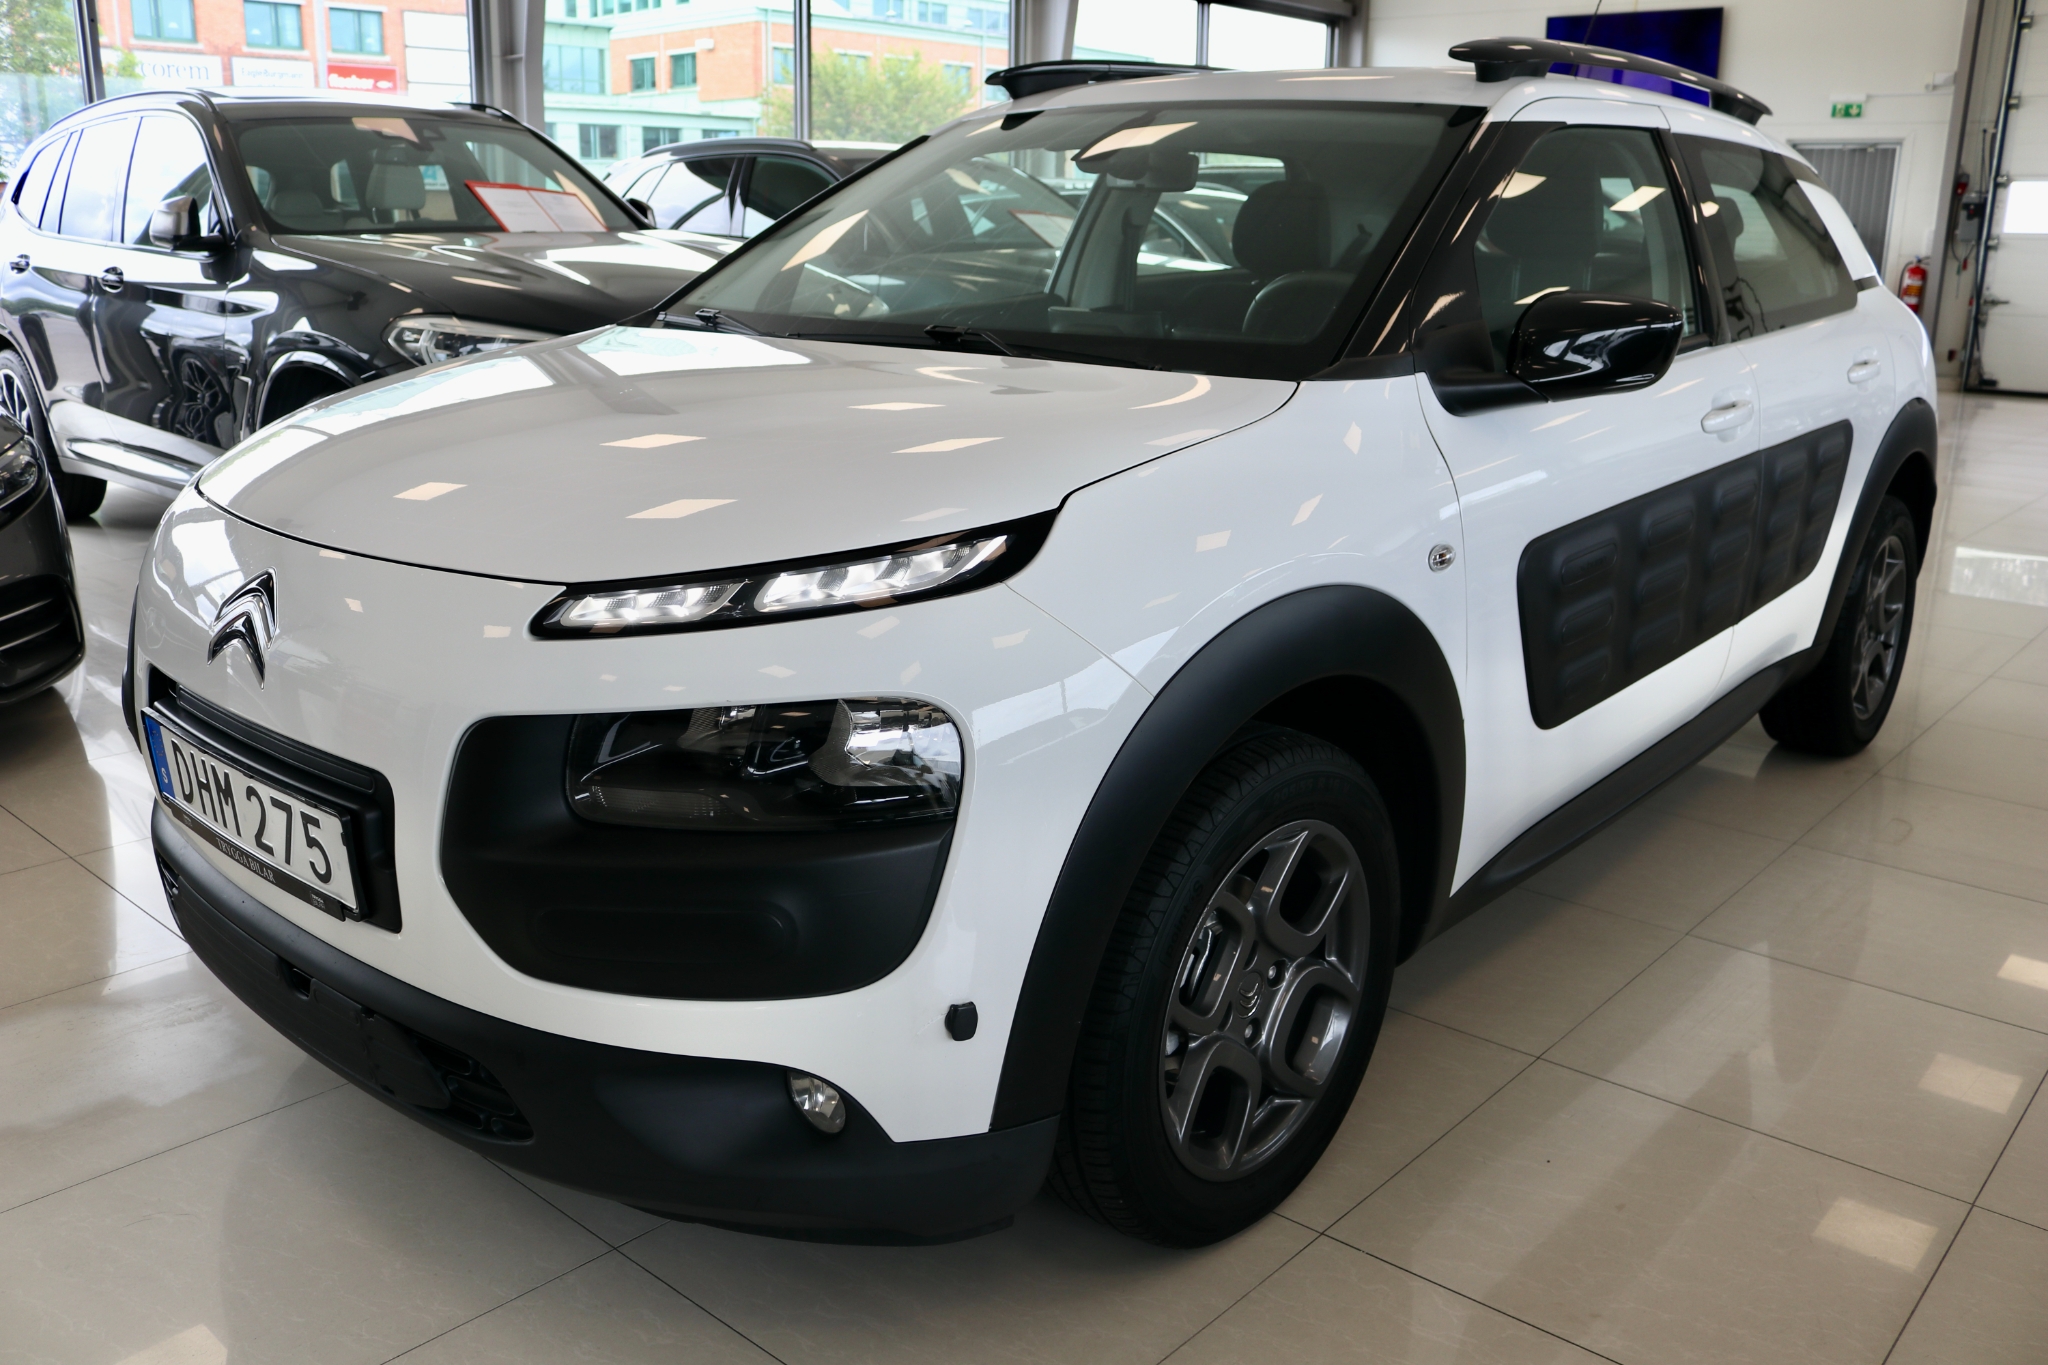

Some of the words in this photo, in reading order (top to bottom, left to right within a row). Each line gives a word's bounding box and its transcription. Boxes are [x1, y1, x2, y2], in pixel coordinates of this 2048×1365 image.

[140, 62, 209, 80] corem
[161, 767, 169, 784] S
[171, 738, 242, 838] DHM
[246, 783, 332, 884] 275
[216, 837, 249, 867] TRYGGA
[248, 858, 276, 883] BILAR
